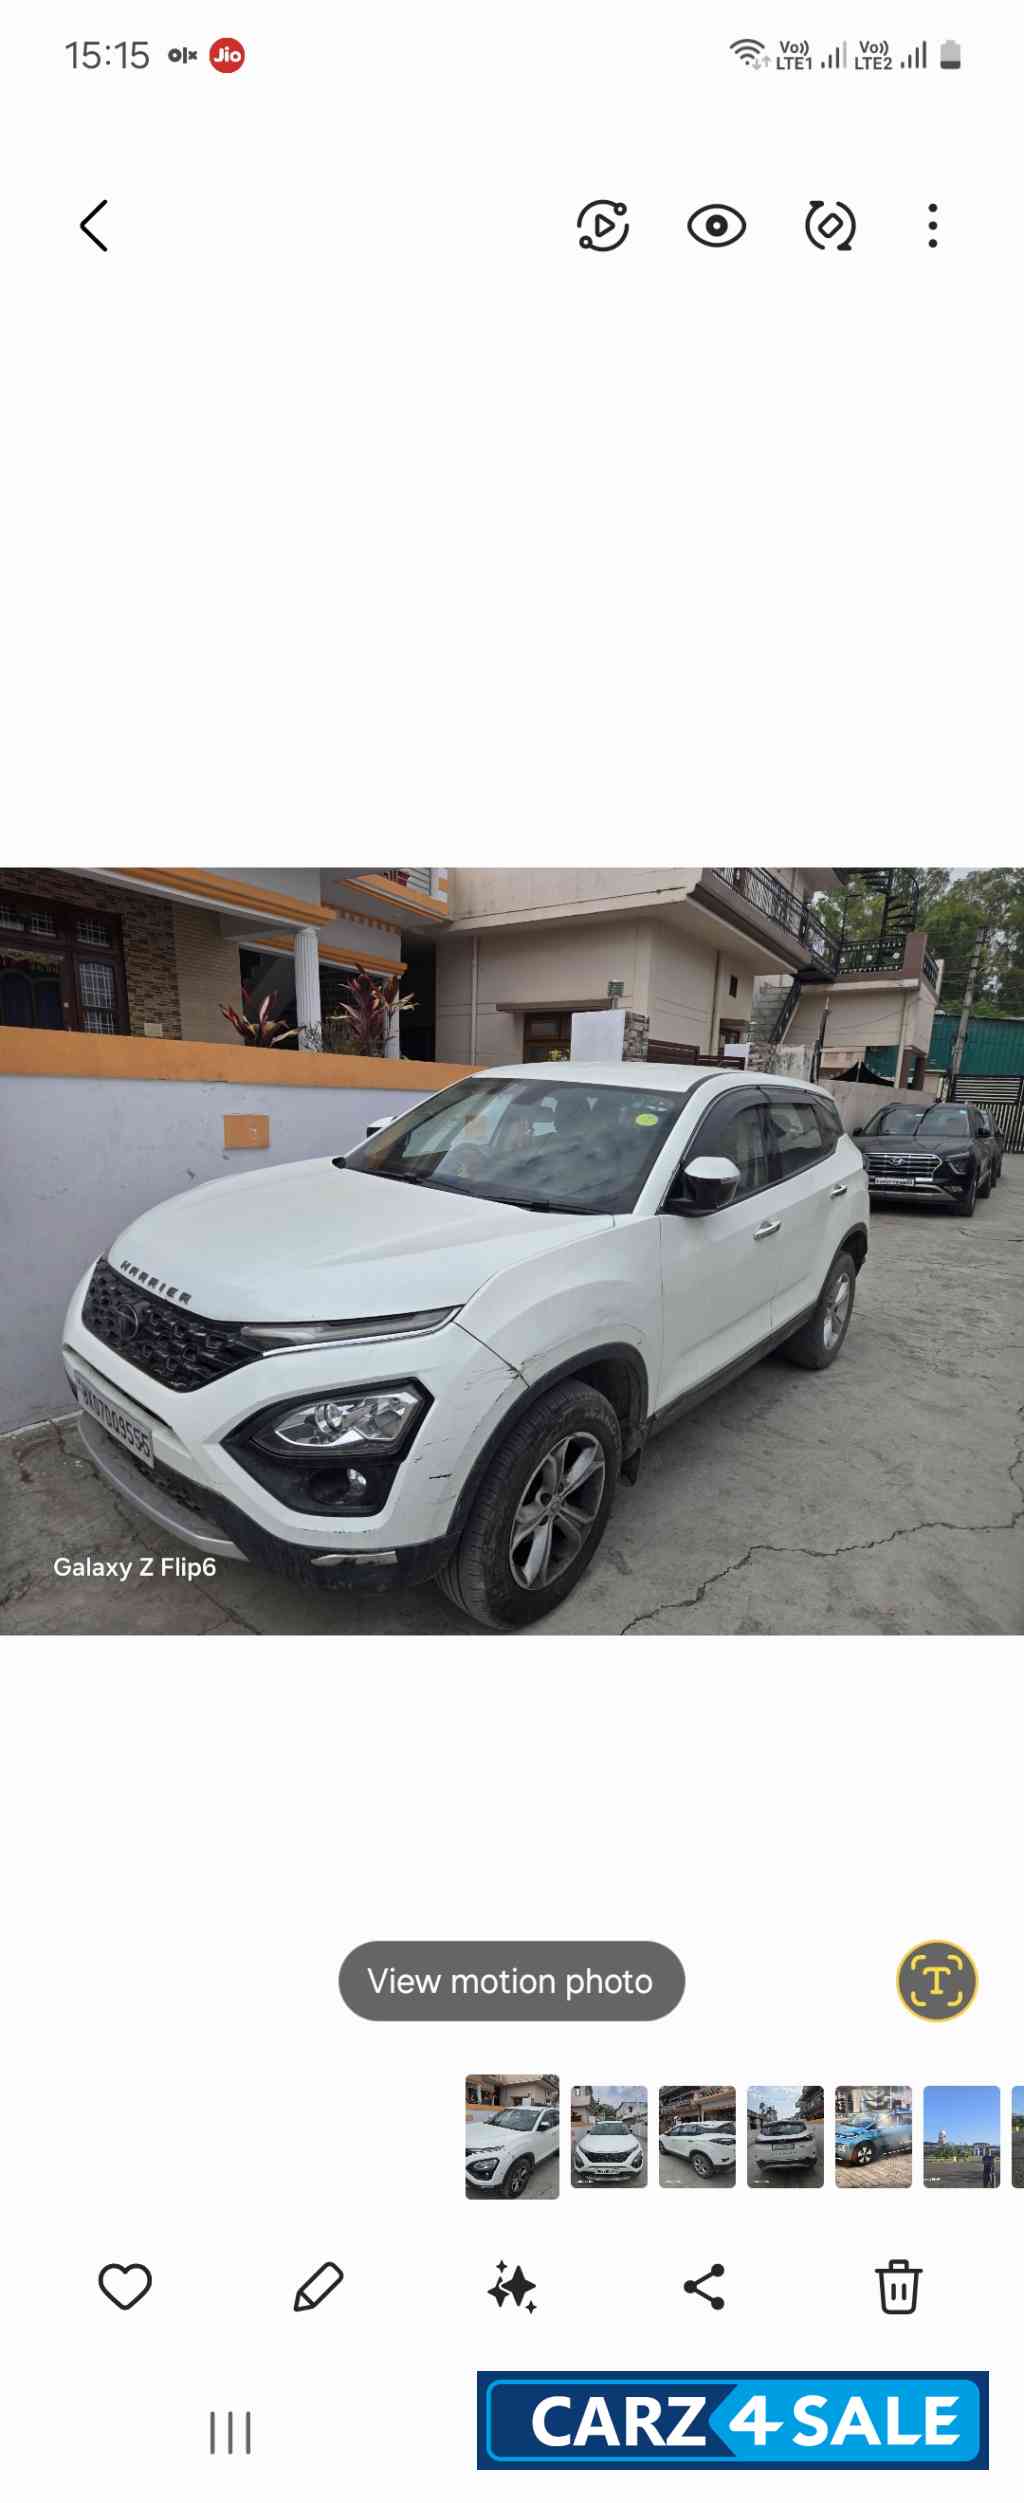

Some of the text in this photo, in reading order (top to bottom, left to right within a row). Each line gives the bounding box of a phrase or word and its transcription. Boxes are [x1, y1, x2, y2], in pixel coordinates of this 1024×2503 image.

[66, 41, 149, 69] 15:15
[214, 46, 241, 63] Jio
[776, 57, 812, 70] LTE1
[855, 57, 893, 70] LTE2
[120, 1260, 192, 1305] HARRIER
[367, 1967, 653, 2001] View motion photo
